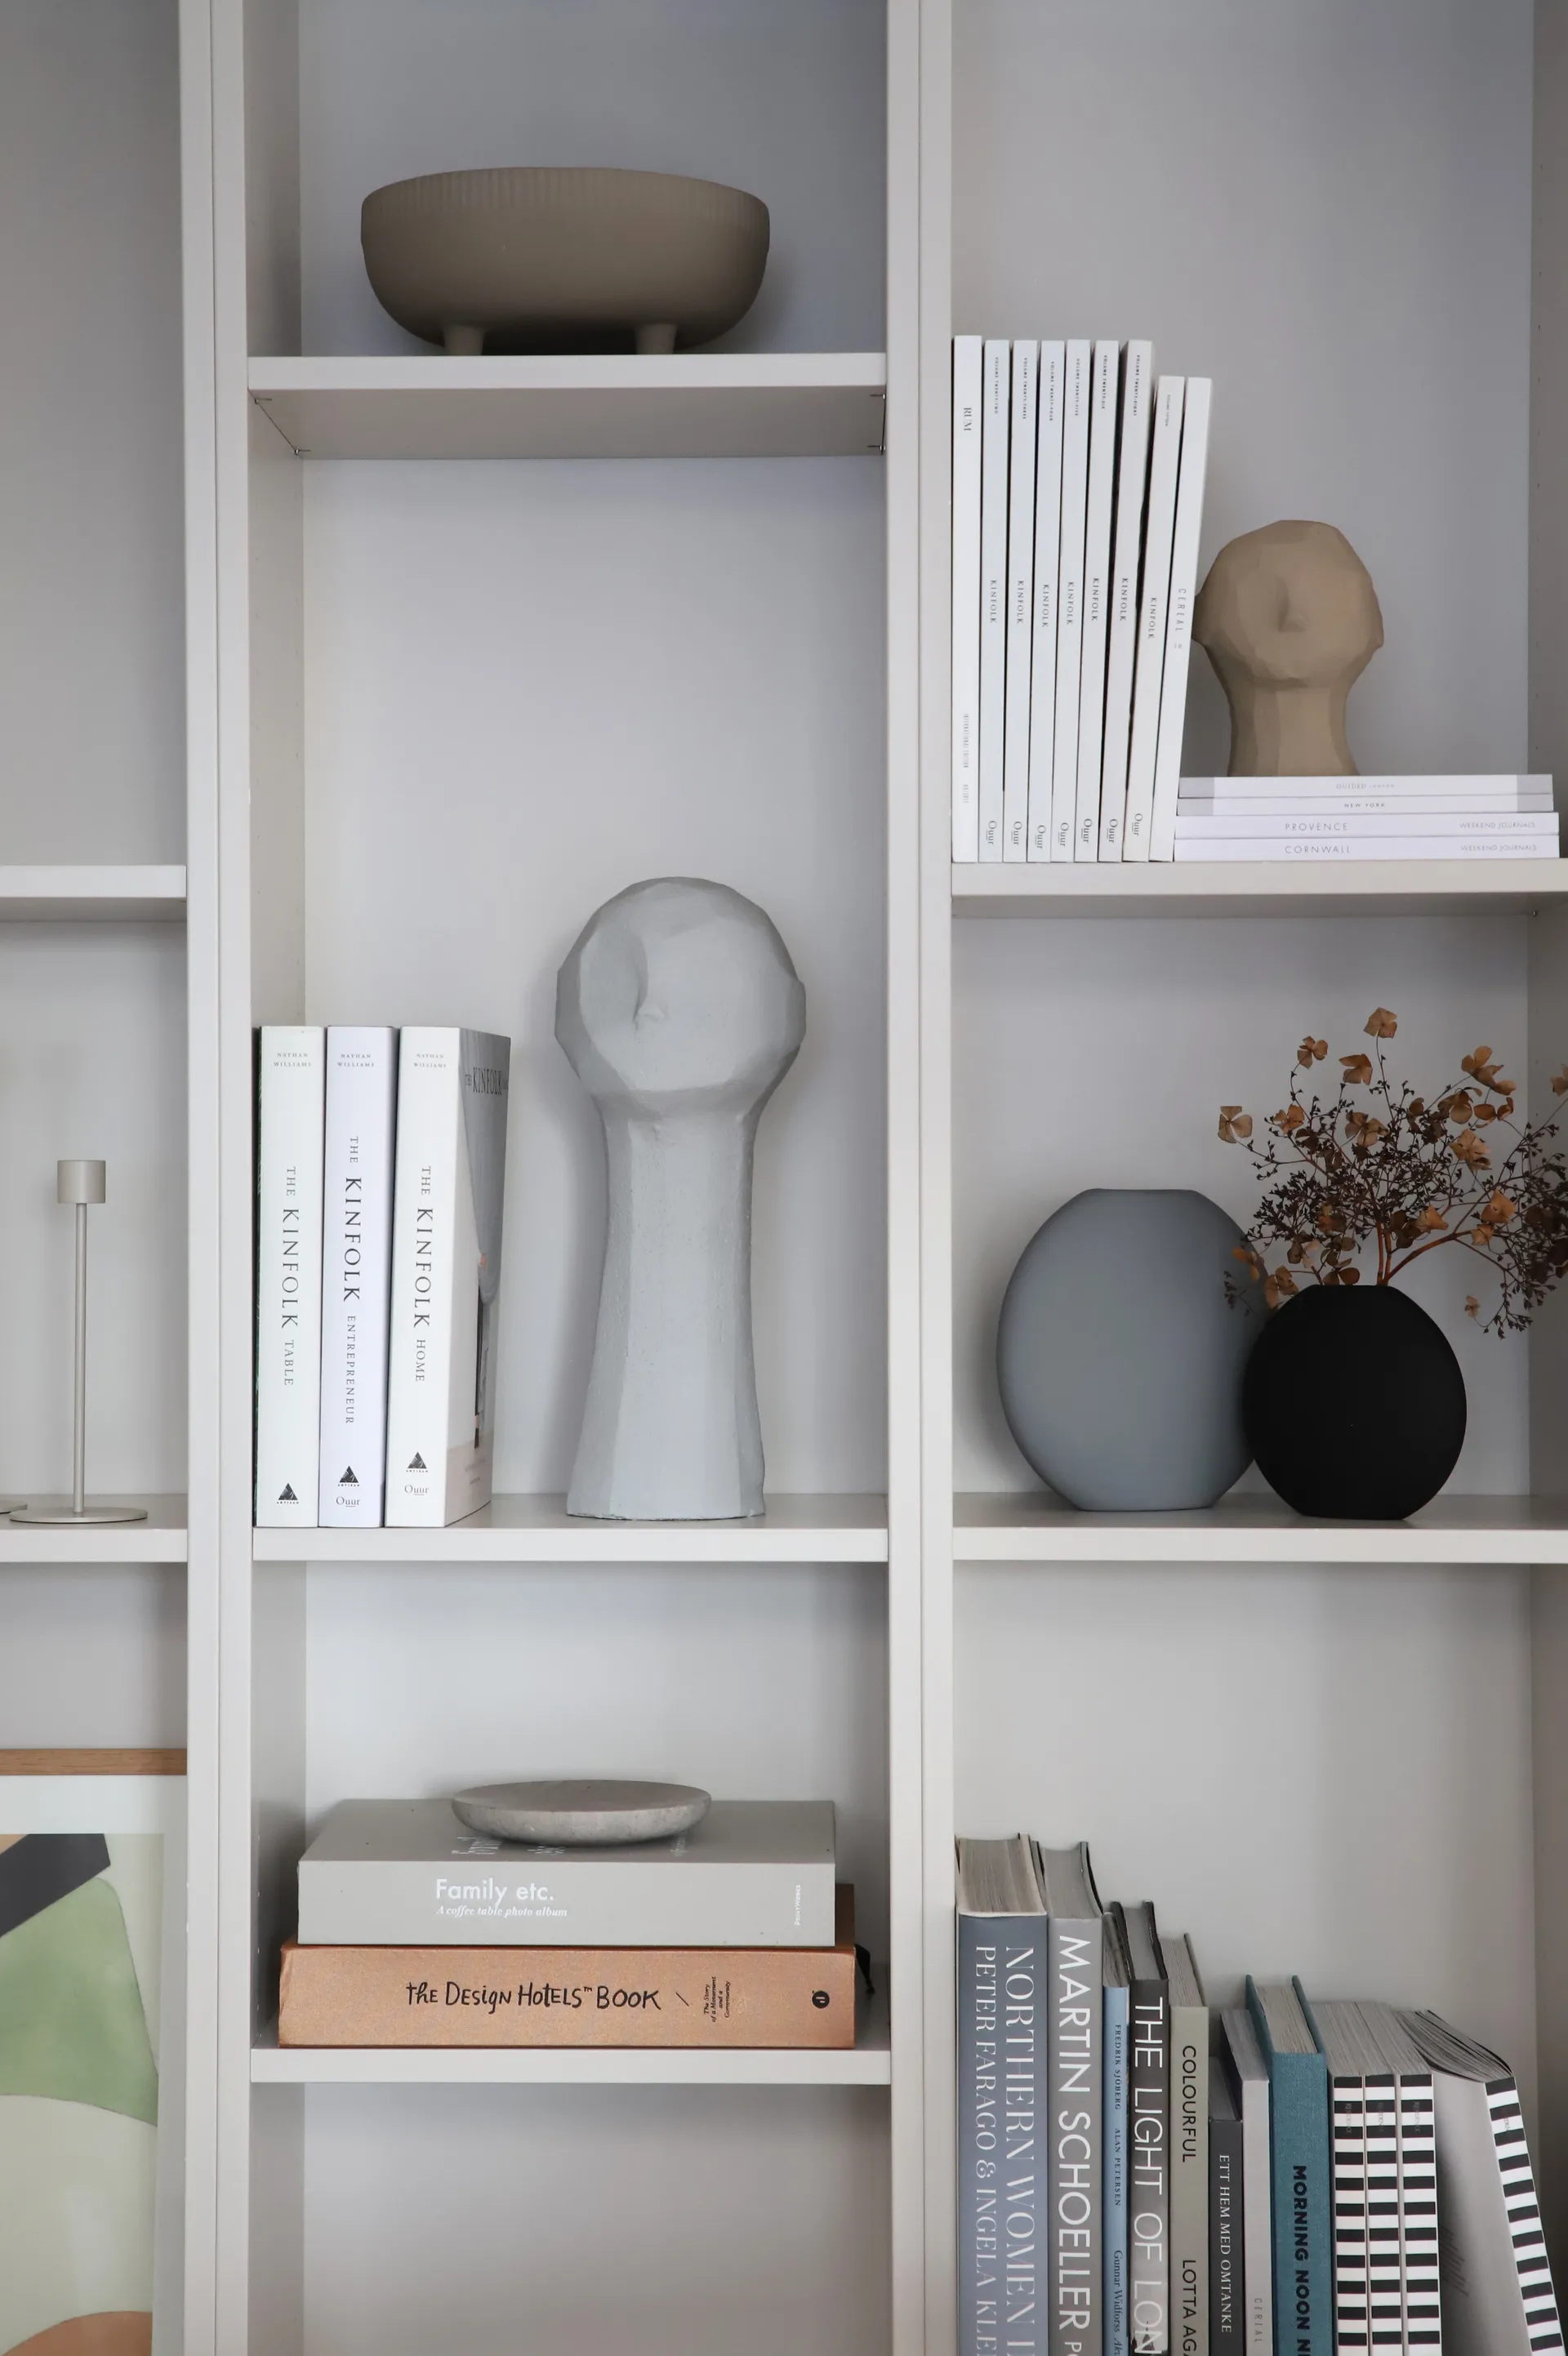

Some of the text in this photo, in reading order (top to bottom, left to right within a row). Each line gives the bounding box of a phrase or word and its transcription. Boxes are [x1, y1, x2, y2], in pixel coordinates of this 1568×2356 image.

[963, 408, 972, 431] RUM
[1091, 578, 1099, 621] KINFOLK
[1120, 578, 1129, 621] KINFOLK
[1148, 598, 1156, 639] KINFOLK
[1175, 588, 1187, 632] CEREAL
[987, 821, 996, 845] Ouur
[1011, 821, 1022, 846] Ouur
[1036, 825, 1046, 849] Ouur
[1058, 822, 1069, 847] Ouur
[1081, 818, 1093, 844] Ouur
[1107, 819, 1118, 844] Ouur
[1132, 813, 1143, 836] Ouur
[1285, 822, 1348, 831] PROVENCE
[1284, 845, 1351, 854] CORNWALL
[1499, 844, 1537, 852] JOURNALS
[282, 1166, 299, 1386] THE KINFOLK TABLE
[343, 1136, 362, 1424] THE KINFOLK ENTREPRENEUR
[413, 1165, 433, 1382] THE KINFOLK HOME
[336, 1496, 360, 1508] Ouur
[404, 1485, 429, 1495] Ouur
[435, 1877, 555, 1908] Family etc.
[436, 1904, 568, 1918] A coffee table photo album
[596, 1985, 662, 2010] BOOK
[1114, 2069, 1122, 2110] SJÖBERG
[976, 1946, 996, 2356] PETER FARAGO & INGELA KLE
[1005, 1946, 1035, 2356] NORTHERN WOMEN I
[1058, 1935, 1091, 2356] MARTIN SCHOELLER P
[1134, 1997, 1163, 2354] THE LIGHT OF LON
[1182, 2045, 1196, 2356] COLOURFUL LOTTA AG
[1293, 2165, 1309, 2261] MORNING
[1219, 2154, 1232, 2333] ETT HEM MED OMTANKE
[1113, 2250, 1123, 2287] Gunnar
[1113, 2289, 1123, 2332] Widforss
[1296, 2270, 1310, 2330] NOON
